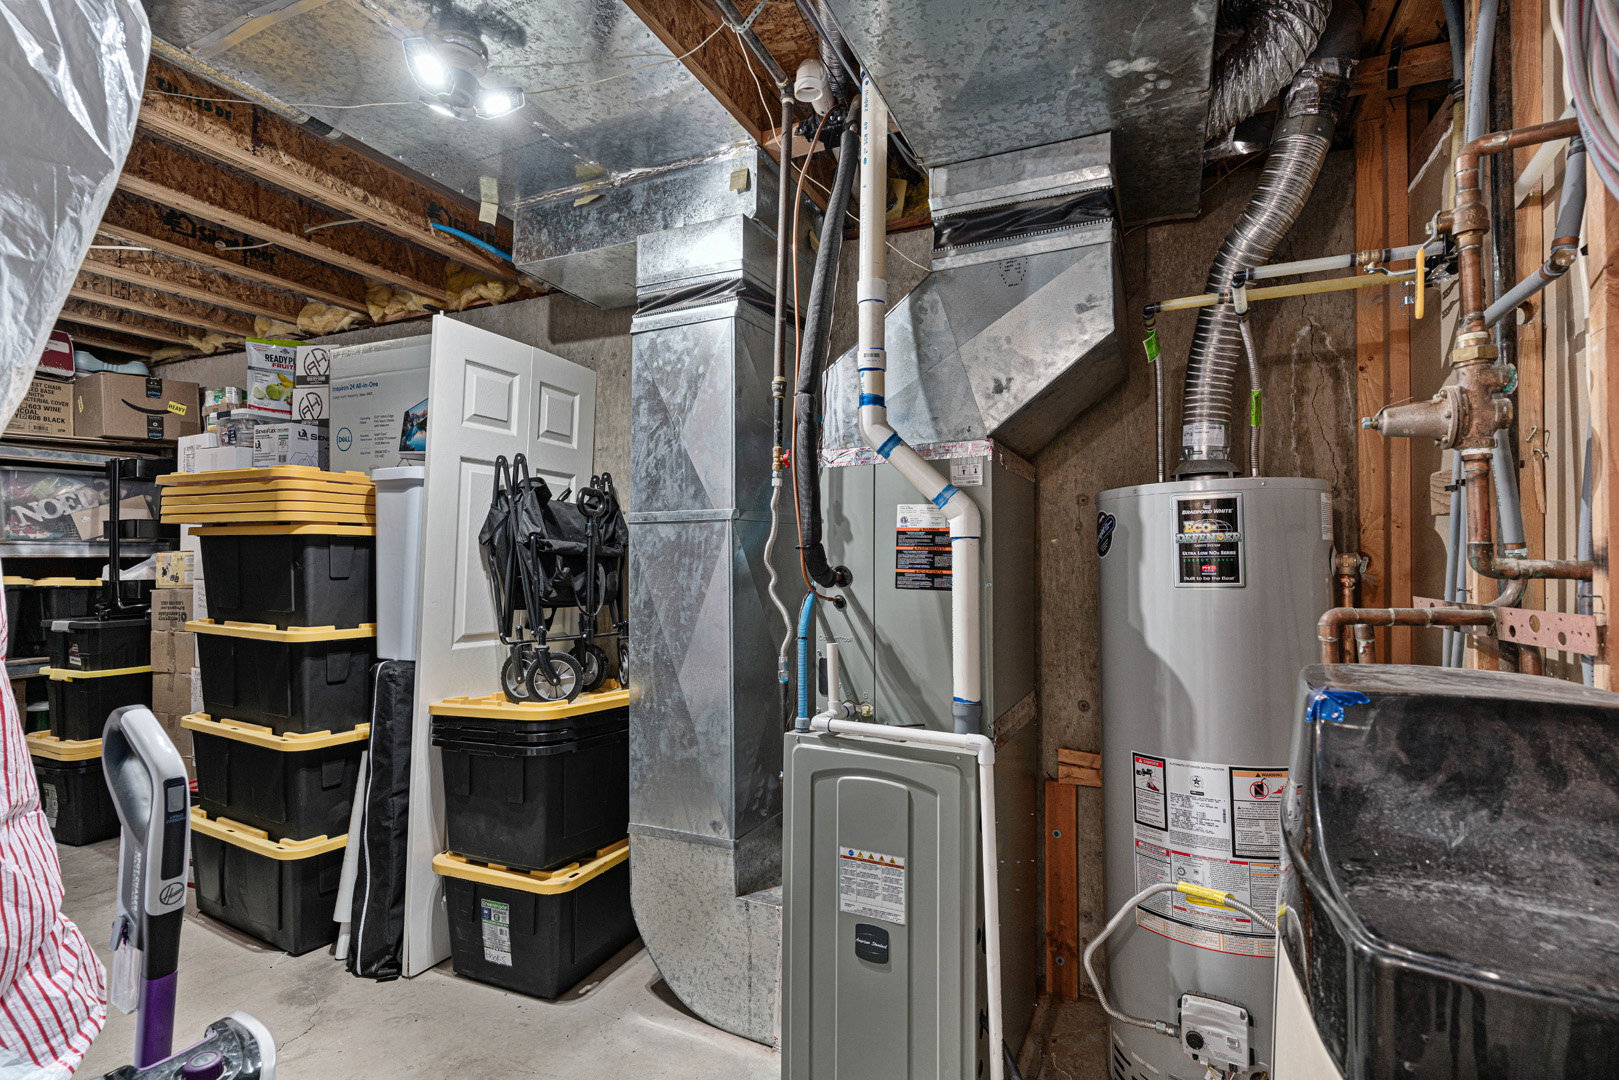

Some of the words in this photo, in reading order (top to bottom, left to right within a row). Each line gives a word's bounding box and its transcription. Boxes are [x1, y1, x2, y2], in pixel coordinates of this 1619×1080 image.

[264, 353, 289, 364] READY
[356, 381, 378, 390] All-in-One
[168, 404, 186, 413] HEAVY
[10, 491, 98, 526] NOEL
[1176, 532, 1242, 543] DEFENDER
[871, 940, 888, 949] Standard
